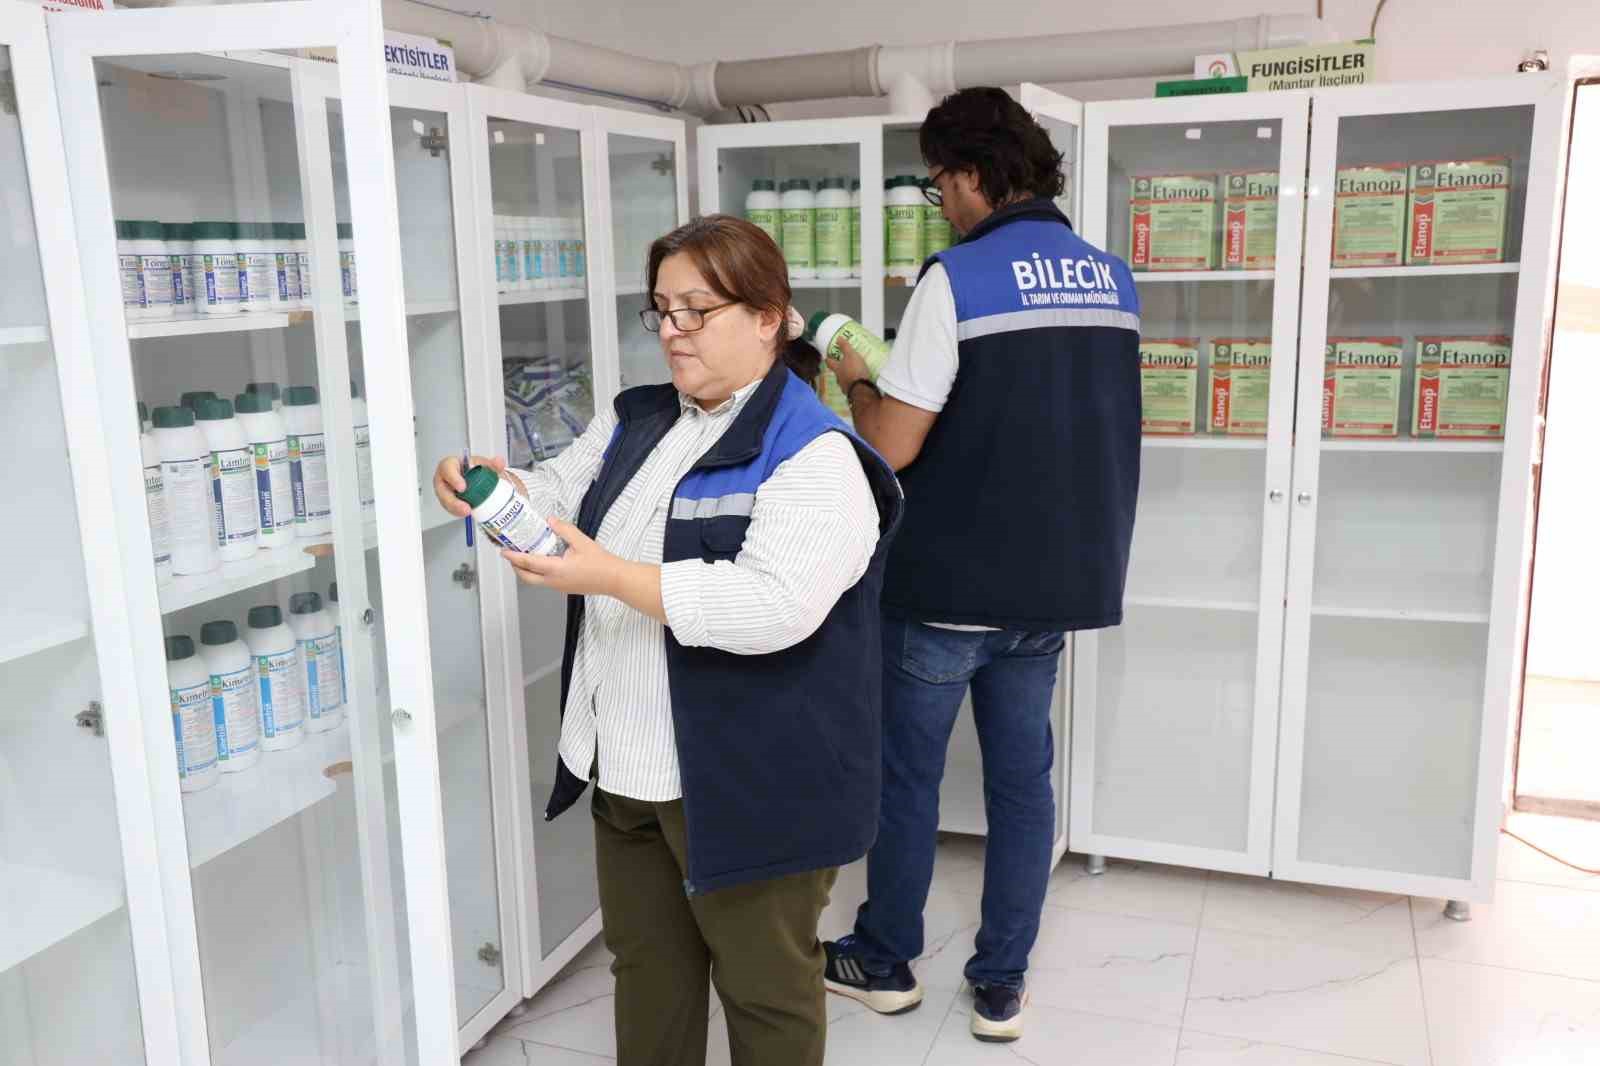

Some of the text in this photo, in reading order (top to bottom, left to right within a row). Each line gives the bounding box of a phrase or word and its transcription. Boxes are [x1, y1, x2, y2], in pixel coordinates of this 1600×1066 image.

[1251, 53, 1365, 79] FUNGİSİTLER
[1152, 183, 1209, 200] Etanop
[1339, 177, 1401, 194] Etanop
[1437, 171, 1503, 188] Etanop
[1134, 223, 1150, 263] Etanop
[1228, 221, 1244, 262] Etanop
[1414, 213, 1432, 257] Etanop
[1011, 251, 1118, 290] BİLECİK
[1338, 350, 1398, 368] Etanop
[1442, 350, 1506, 368] Etanop
[1215, 387, 1229, 427] Etanop
[1419, 388, 1438, 430] Etanop
